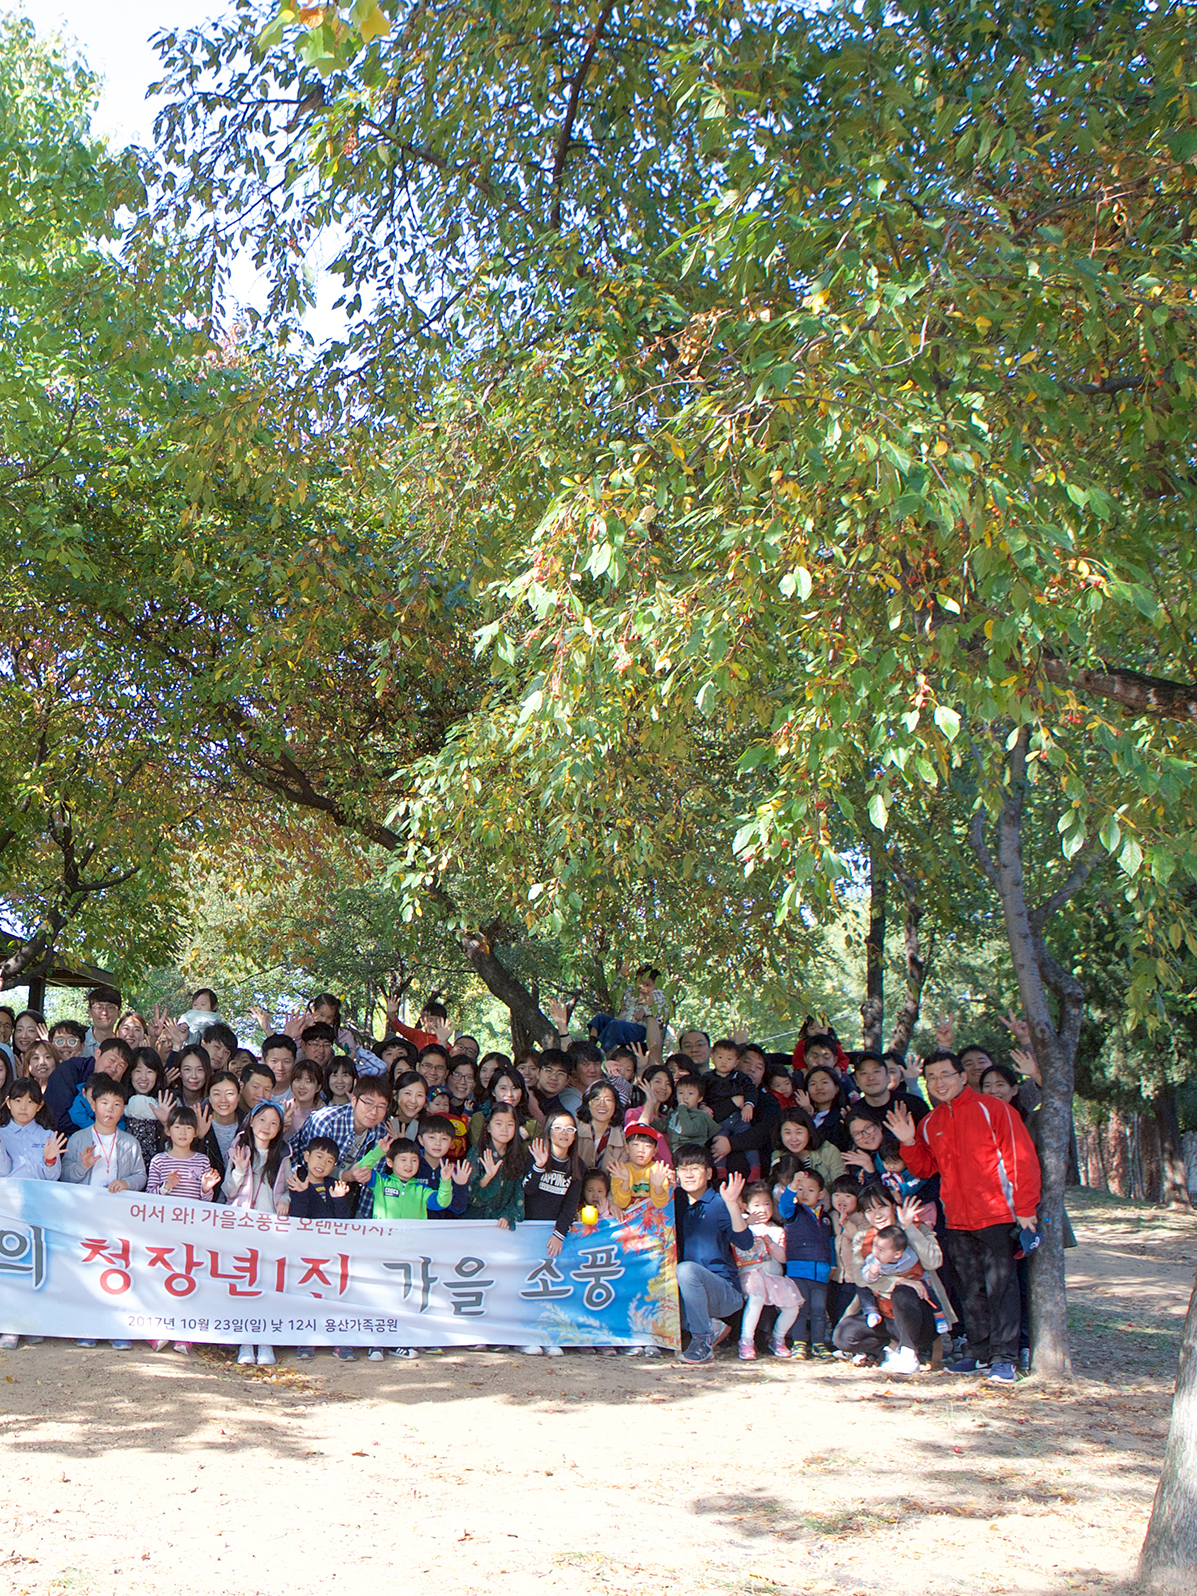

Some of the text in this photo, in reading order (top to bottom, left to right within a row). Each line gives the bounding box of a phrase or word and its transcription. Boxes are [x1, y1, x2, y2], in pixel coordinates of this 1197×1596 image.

[130, 1204, 165, 1224] 어서
[171, 1206, 195, 1225] 와!
[201, 1208, 291, 1233] 가을소풍은
[382, 1255, 494, 1316] 가을
[520, 1247, 624, 1308] 소풍
[128, 1316, 398, 1333] 2017년 10월 23일(일) 낮 12시 용산가족공원
